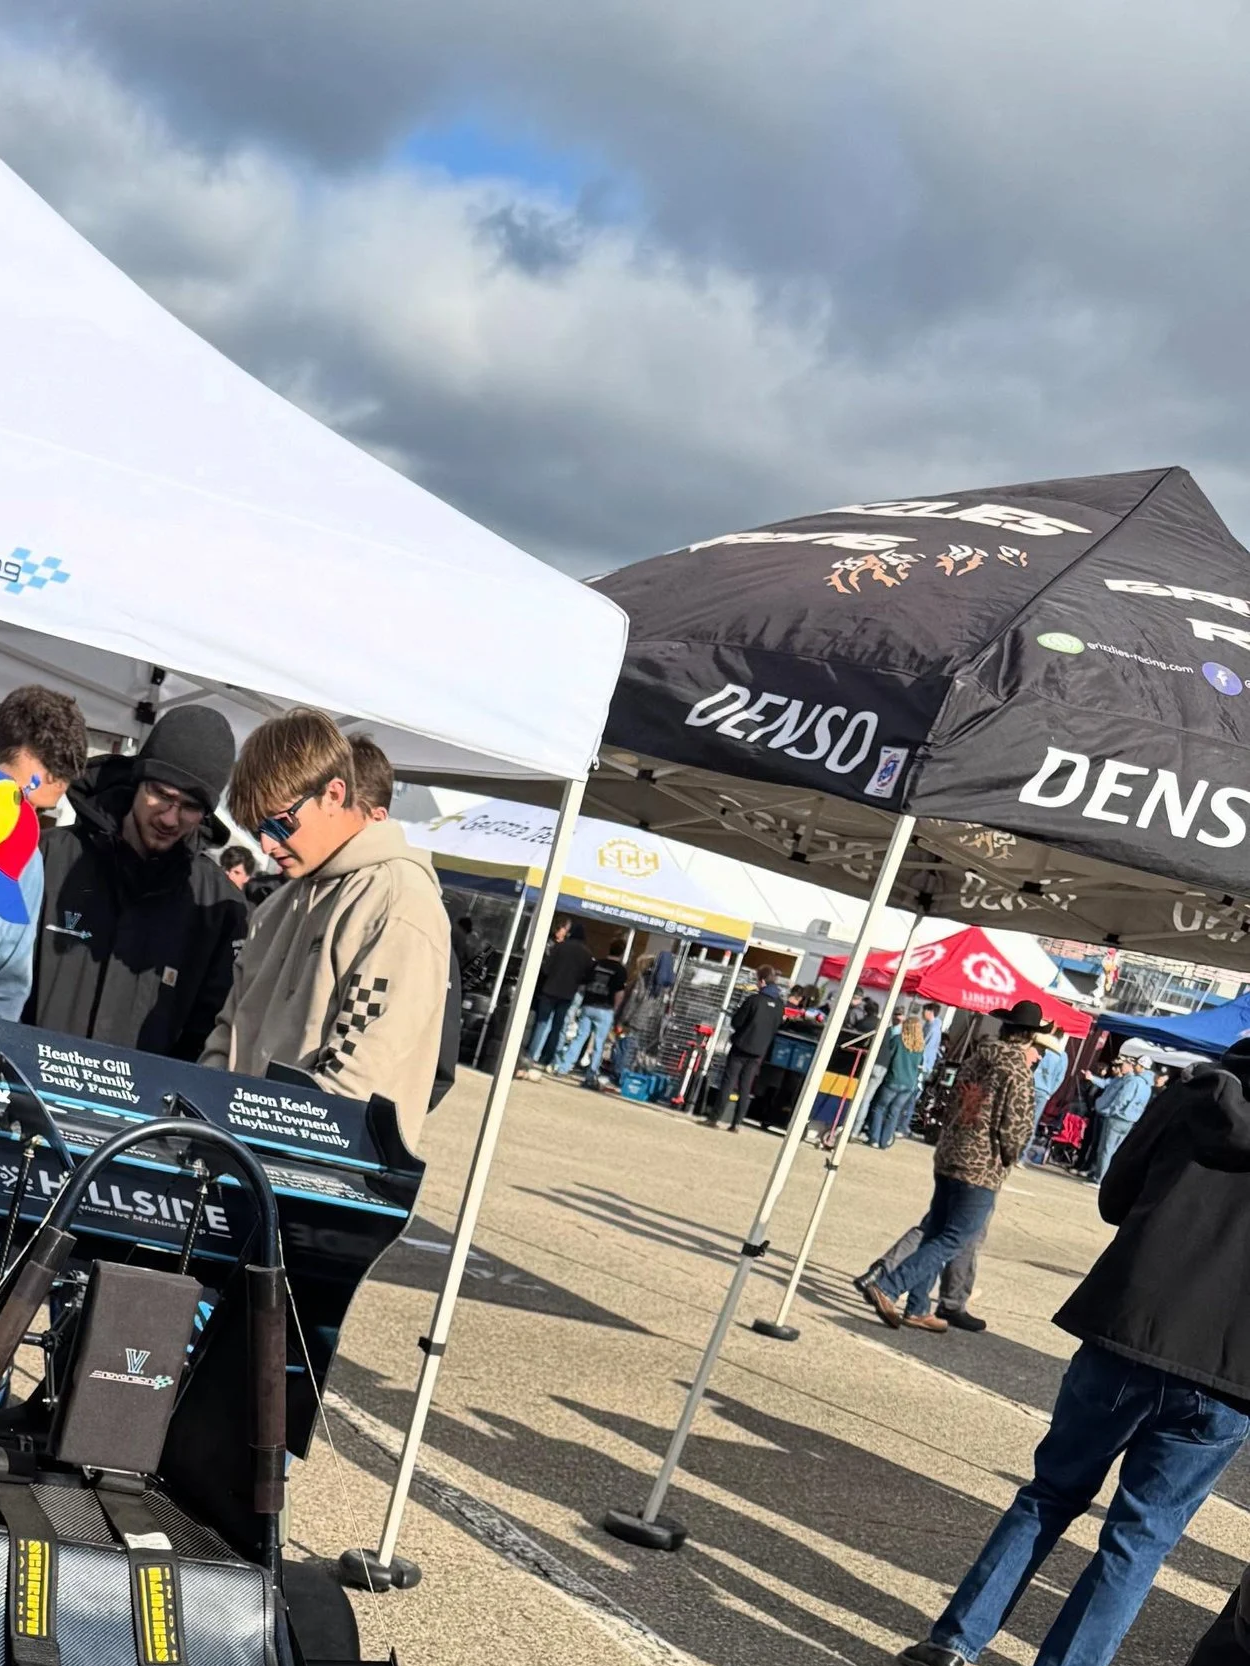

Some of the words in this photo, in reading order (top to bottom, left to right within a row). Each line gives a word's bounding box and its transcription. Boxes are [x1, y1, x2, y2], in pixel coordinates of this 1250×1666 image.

[1087, 641, 1194, 675] grizzlies-racing.com
[684, 683, 879, 774] DENSO
[598, 847, 661, 871] SCC
[37, 1043, 101, 1069] Heather
[103, 1059, 131, 1077] Gill
[40, 1072, 85, 1092] Duffy
[86, 1082, 141, 1104] Family
[81, 1068, 136, 1092] Family
[229, 1101, 270, 1120] Chris
[269, 1109, 341, 1135] Townend
[233, 1087, 278, 1108] Jason
[279, 1096, 329, 1120] Keeley
[227, 1114, 299, 1138] Hayhurst
[298, 1128, 351, 1149] Family
[125, 1347, 151, 1374] V
[26, 1540, 42, 1636] SCHROTH
[148, 1567, 169, 1662] SCHROTH
